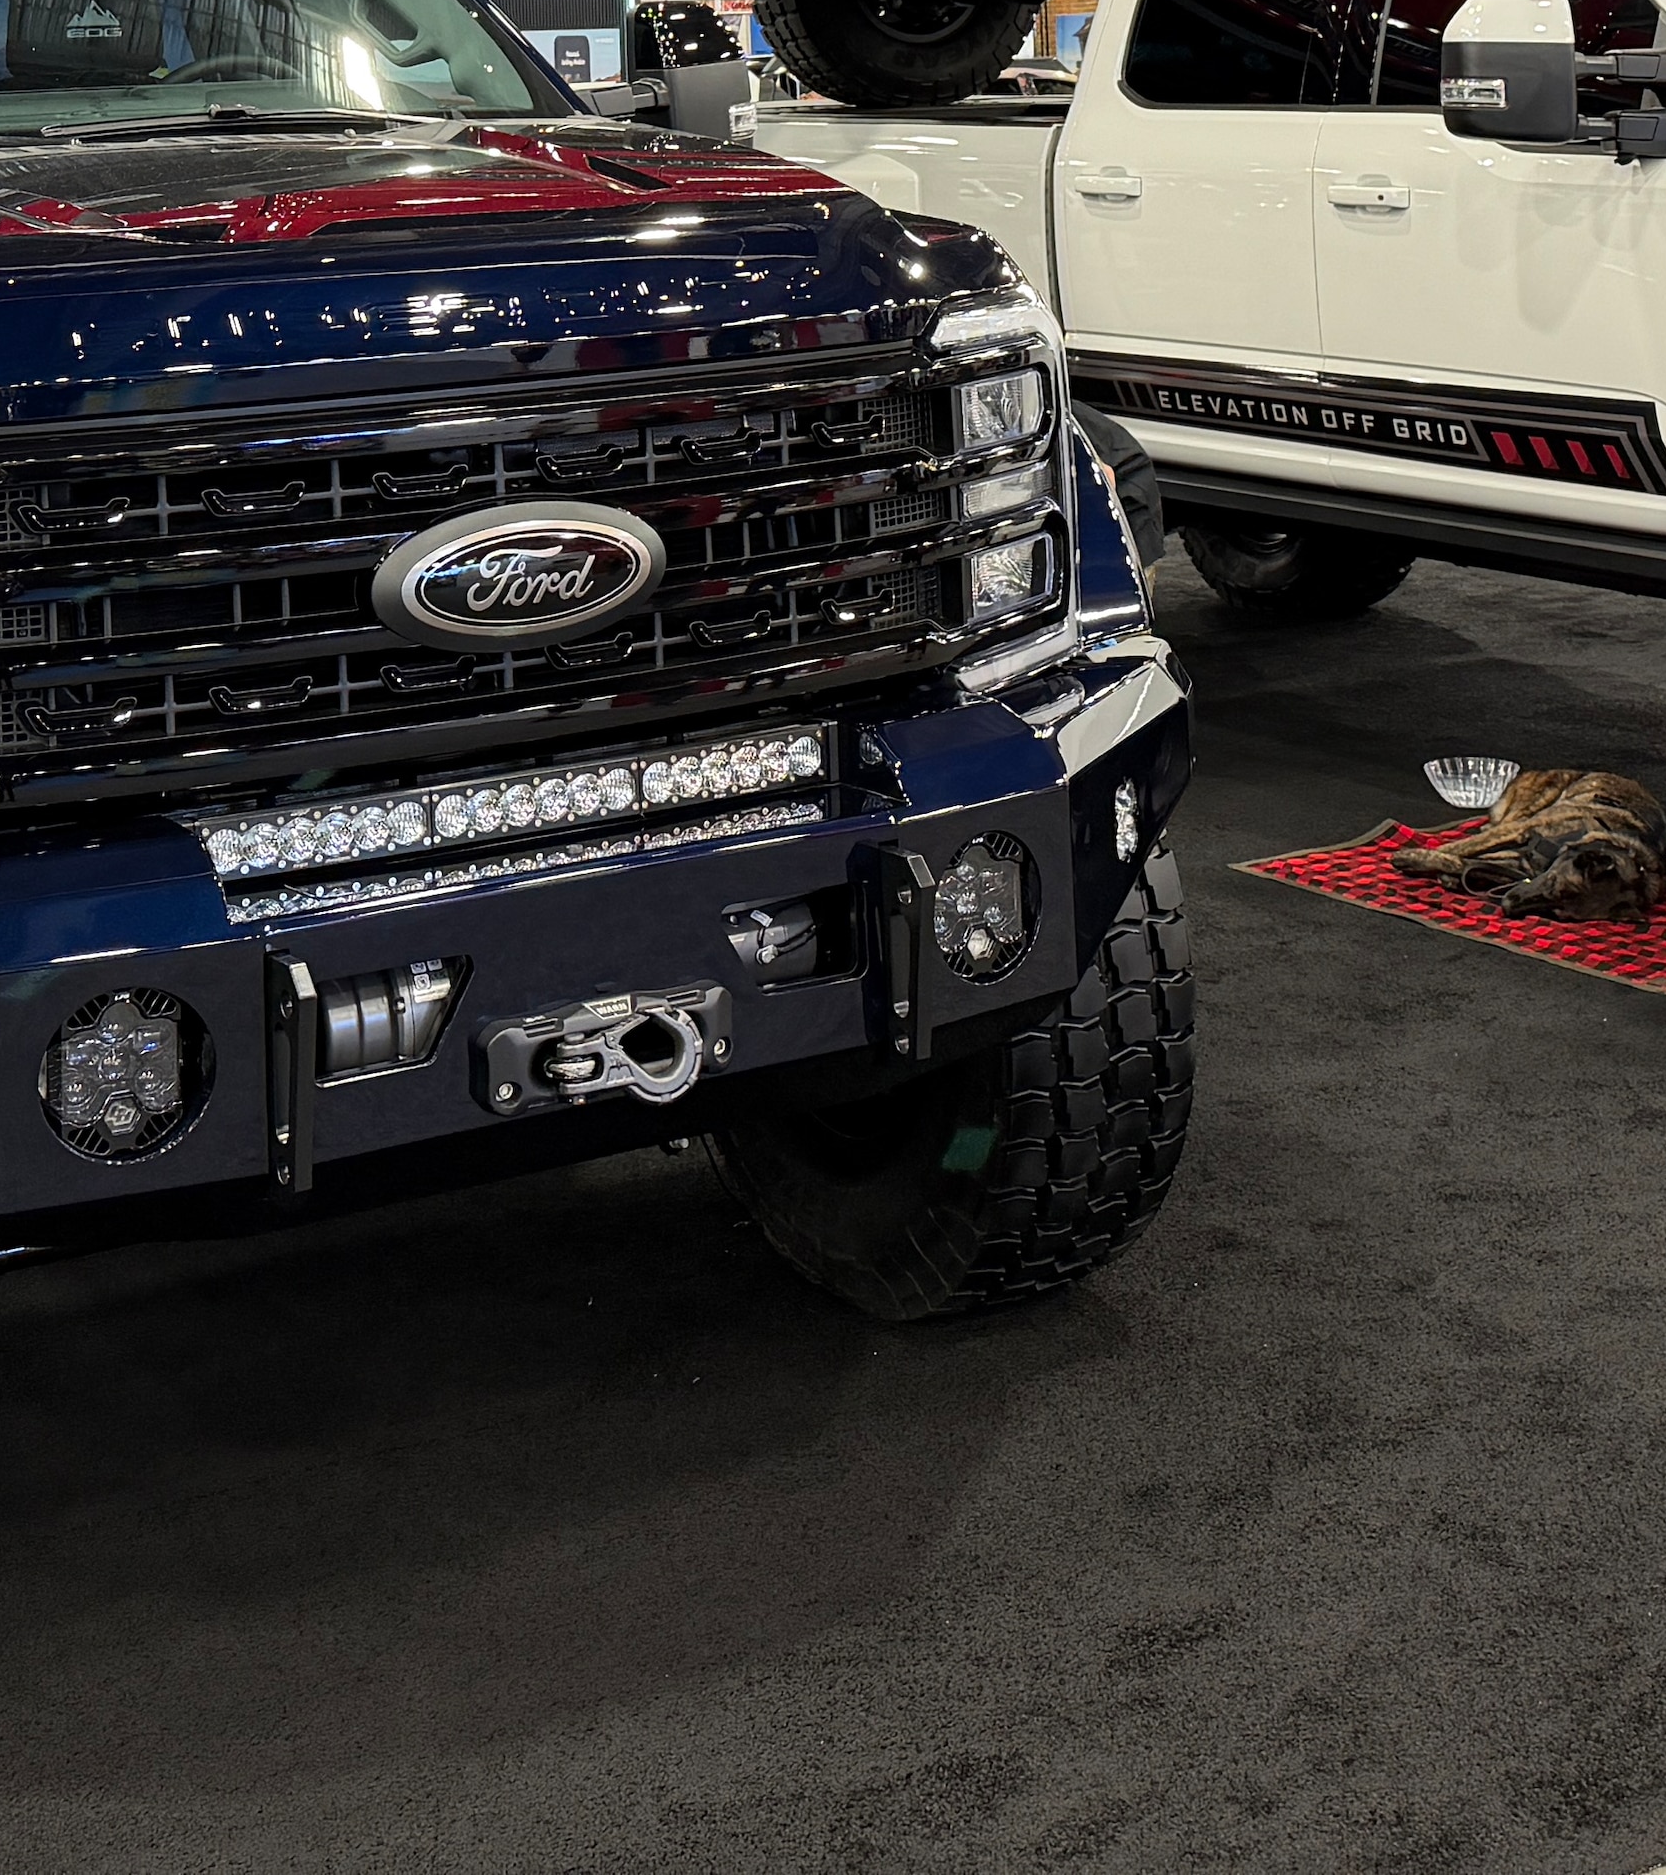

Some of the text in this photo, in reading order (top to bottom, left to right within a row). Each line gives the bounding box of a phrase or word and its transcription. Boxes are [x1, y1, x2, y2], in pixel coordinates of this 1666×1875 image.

[65, 27, 123, 38] EOG
[1157, 389, 1468, 446] ELEVATION OFF GRID
[466, 545, 596, 612] Ford
[596, 1003, 628, 1015] WARN
